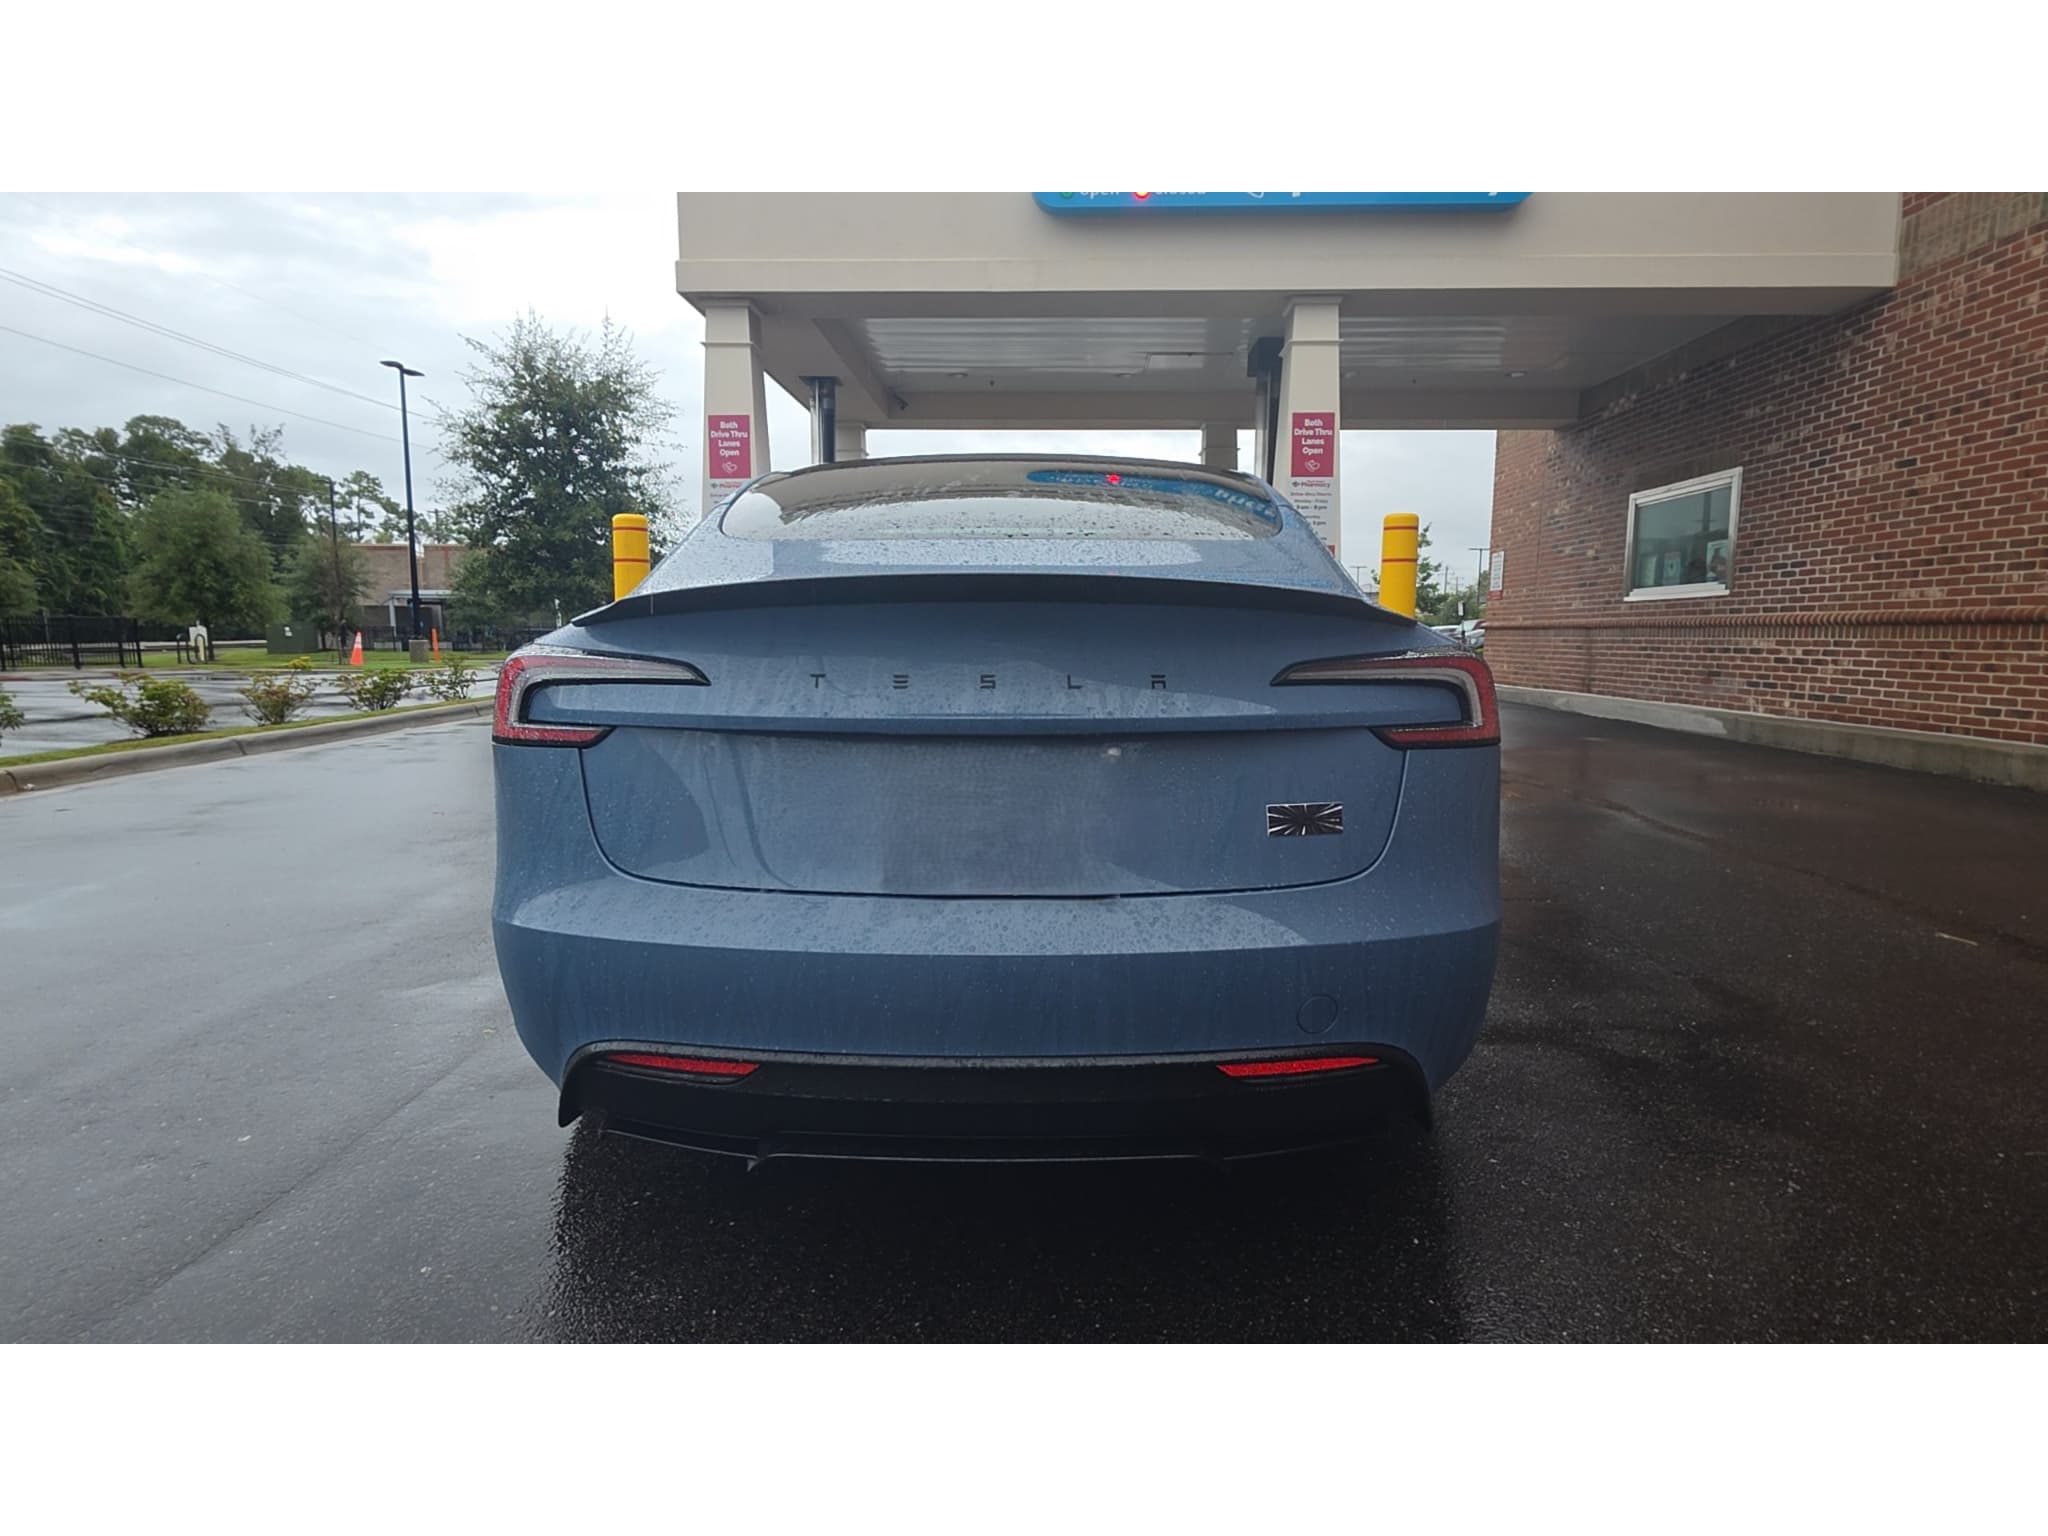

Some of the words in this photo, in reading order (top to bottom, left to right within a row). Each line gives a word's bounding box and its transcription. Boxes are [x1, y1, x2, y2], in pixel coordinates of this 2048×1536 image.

[720, 421, 738, 429] Both
[1304, 419, 1323, 427] Both
[711, 429, 730, 438] Drive
[730, 429, 748, 438] Thru
[1294, 427, 1314, 436] Drive
[1314, 427, 1333, 436] Thru
[718, 439, 740, 447] Lanes
[1301, 437, 1325, 445] Lanes
[720, 449, 739, 457] Open
[1302, 447, 1323, 456] Open
[810, 673, 1166, 690] TESLA
